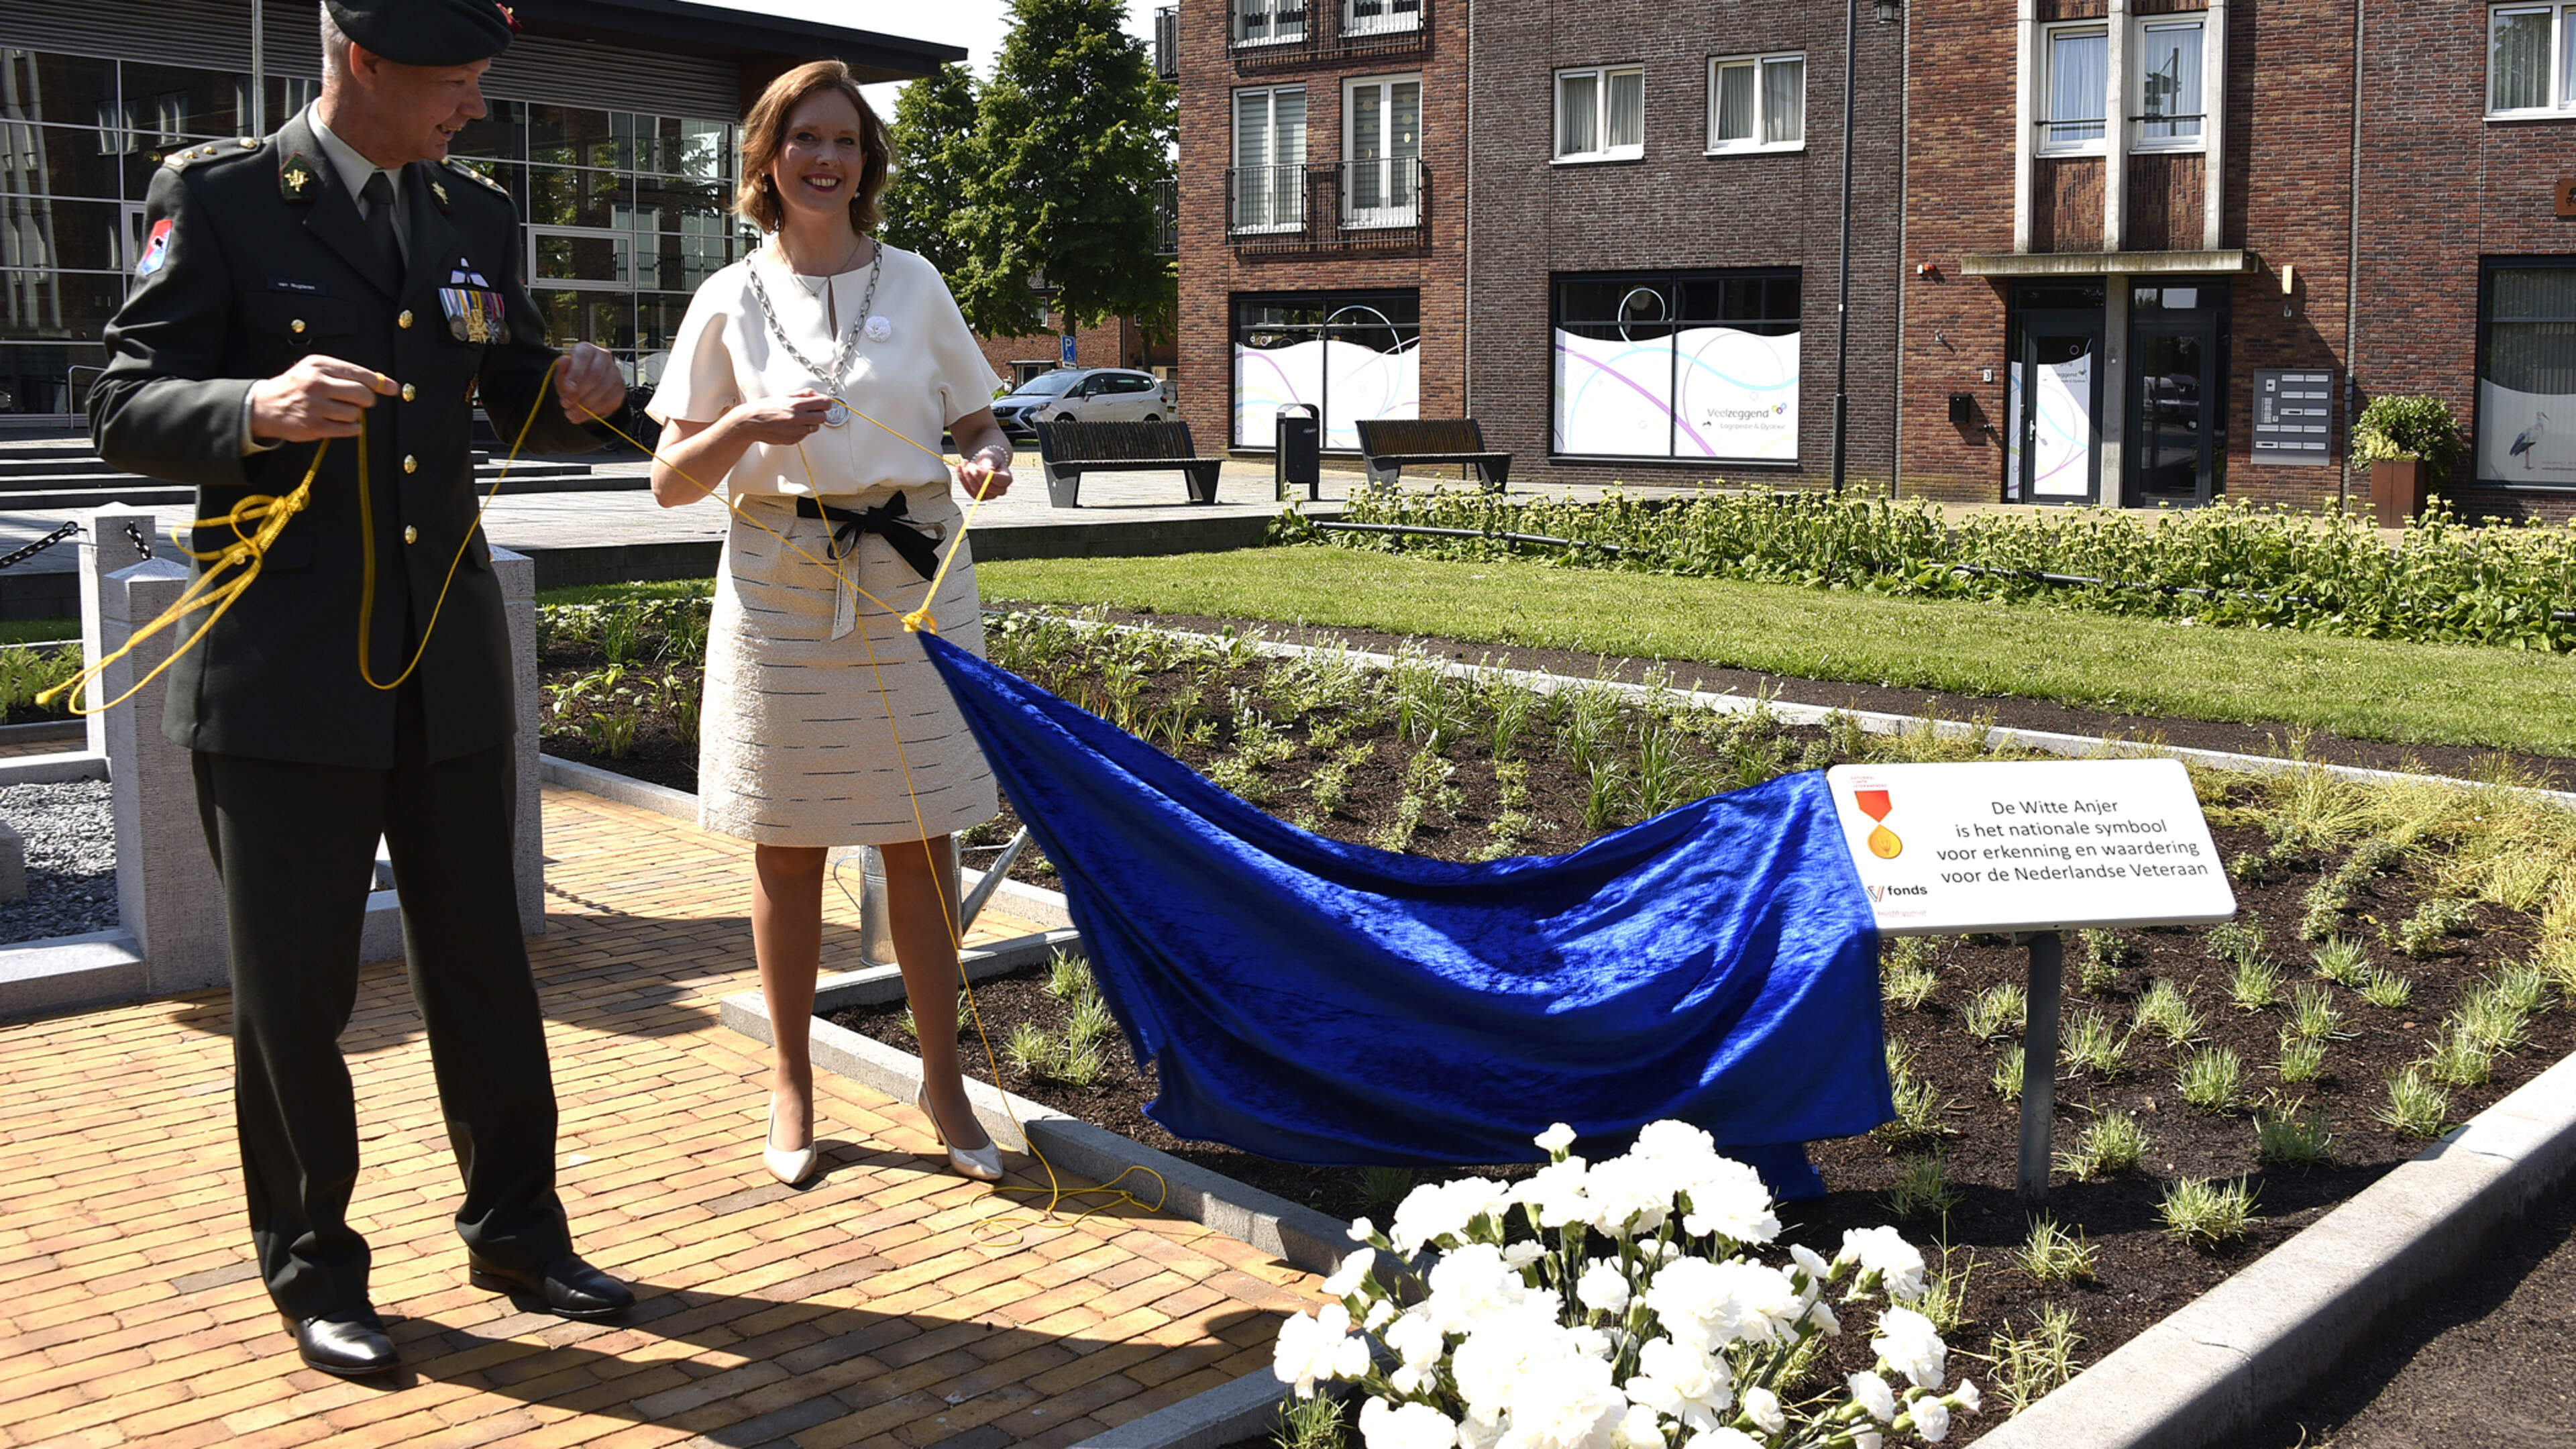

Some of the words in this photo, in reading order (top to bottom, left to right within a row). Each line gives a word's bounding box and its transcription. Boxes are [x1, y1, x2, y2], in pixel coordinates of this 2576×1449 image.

[1065, 337, 1072, 351] P
[1707, 408, 1769, 421] Veelzeggend
[1991, 802, 2015, 815] De
[2019, 801, 2068, 814] Witte
[2074, 800, 2118, 816] Anjer
[1955, 824, 1970, 838] is
[1974, 823, 2004, 837] het
[2009, 820, 2090, 837] nationale
[2094, 819, 2167, 837] symbool
[1937, 849, 1977, 861] voor
[1983, 845, 2072, 861] erkenning
[2076, 846, 2097, 857] en
[2101, 840, 2200, 857] waardering
[1941, 871, 1981, 883] voor
[1988, 867, 2009, 881] de
[2015, 864, 2127, 880] Nederlandse
[2129, 864, 2208, 877] Veteraan
[1888, 885, 1928, 896] fonds
